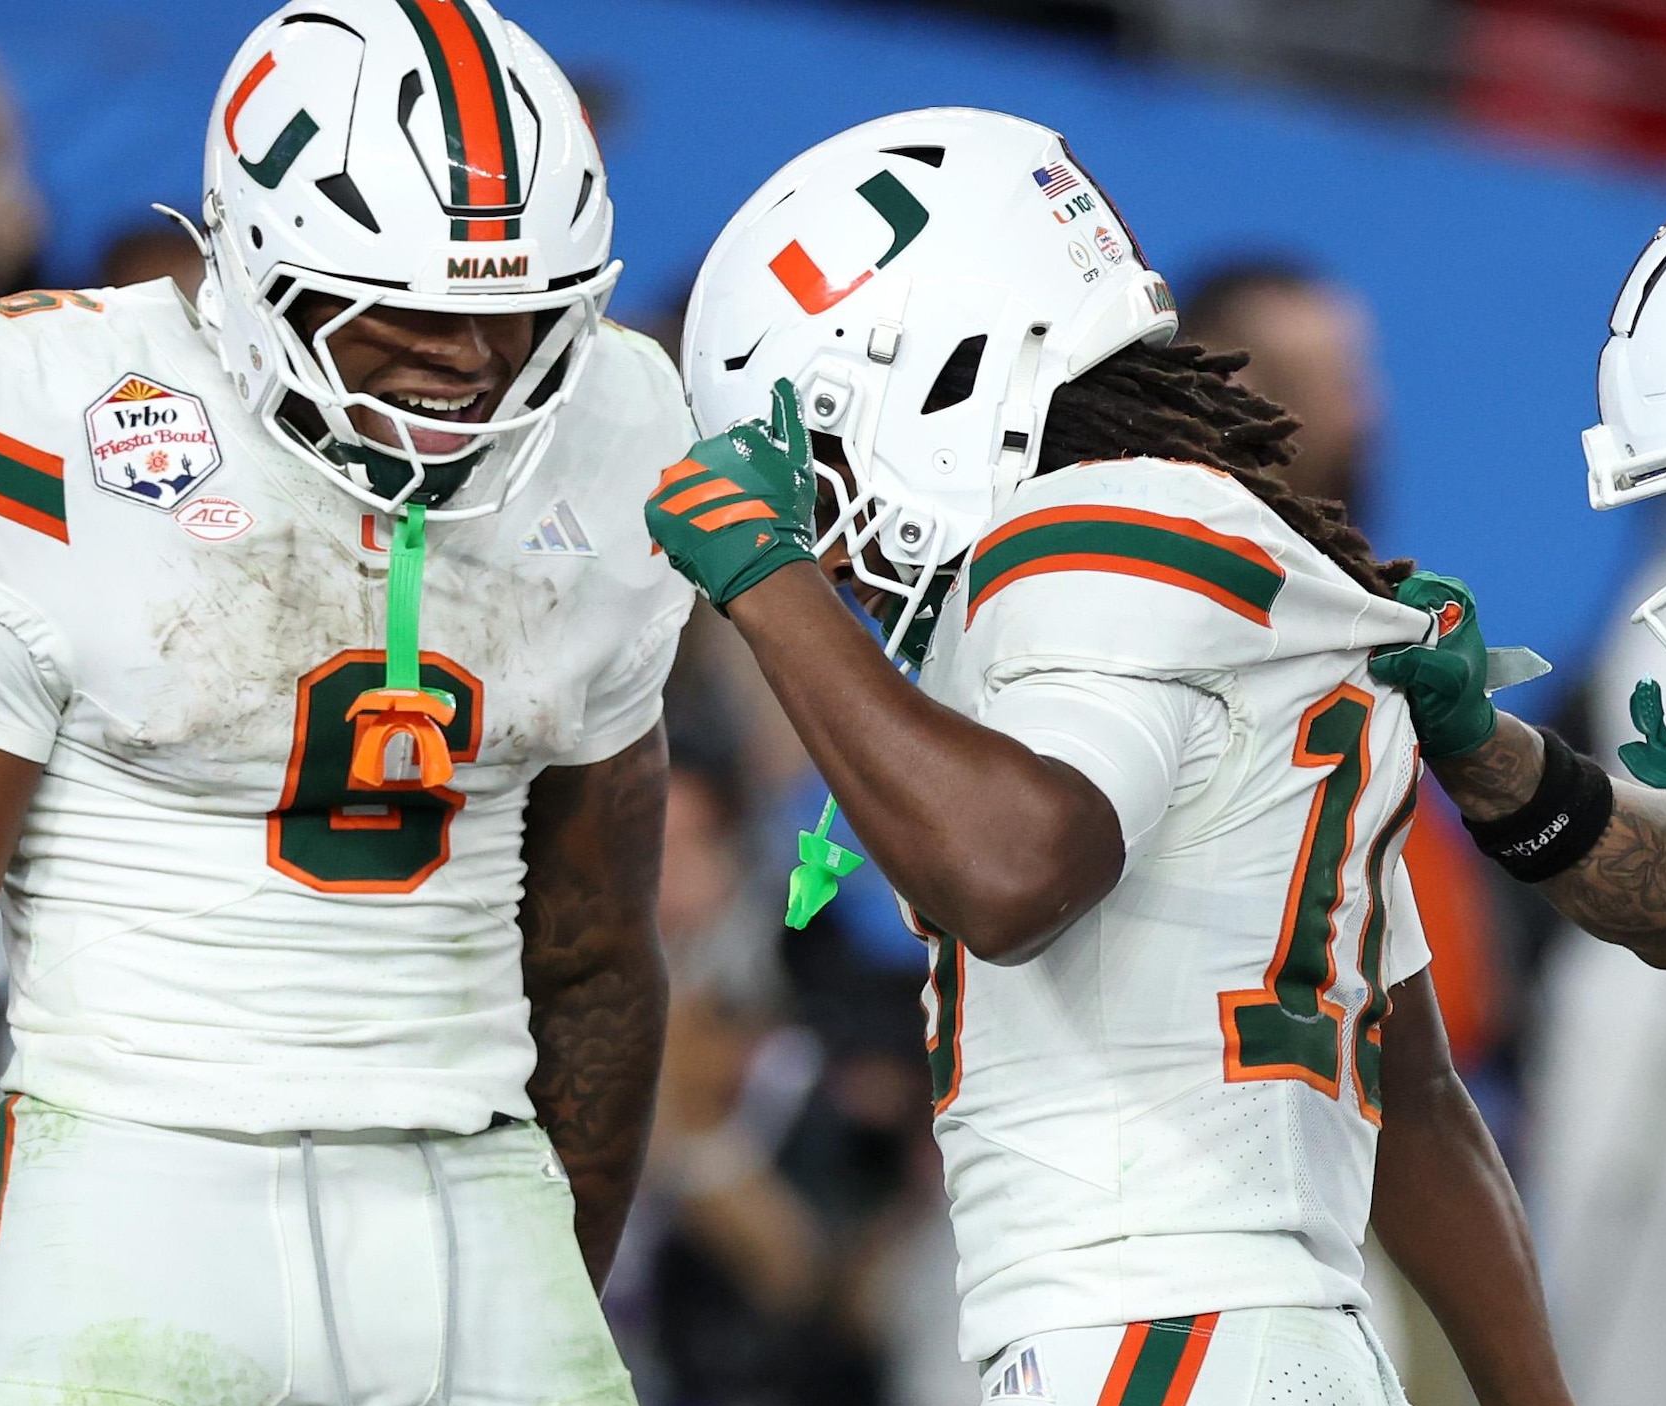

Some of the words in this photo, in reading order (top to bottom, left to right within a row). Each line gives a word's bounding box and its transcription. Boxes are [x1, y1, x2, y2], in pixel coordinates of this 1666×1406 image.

[767, 168, 930, 316] U
[447, 254, 529, 279] MIAMI
[1083, 268, 1100, 283] CFP
[114, 405, 178, 430] Vrbo
[94, 432, 153, 461] Fiesta
[154, 429, 208, 445] Bowl
[188, 508, 242, 525] ACC
[267, 648, 485, 894] 6
